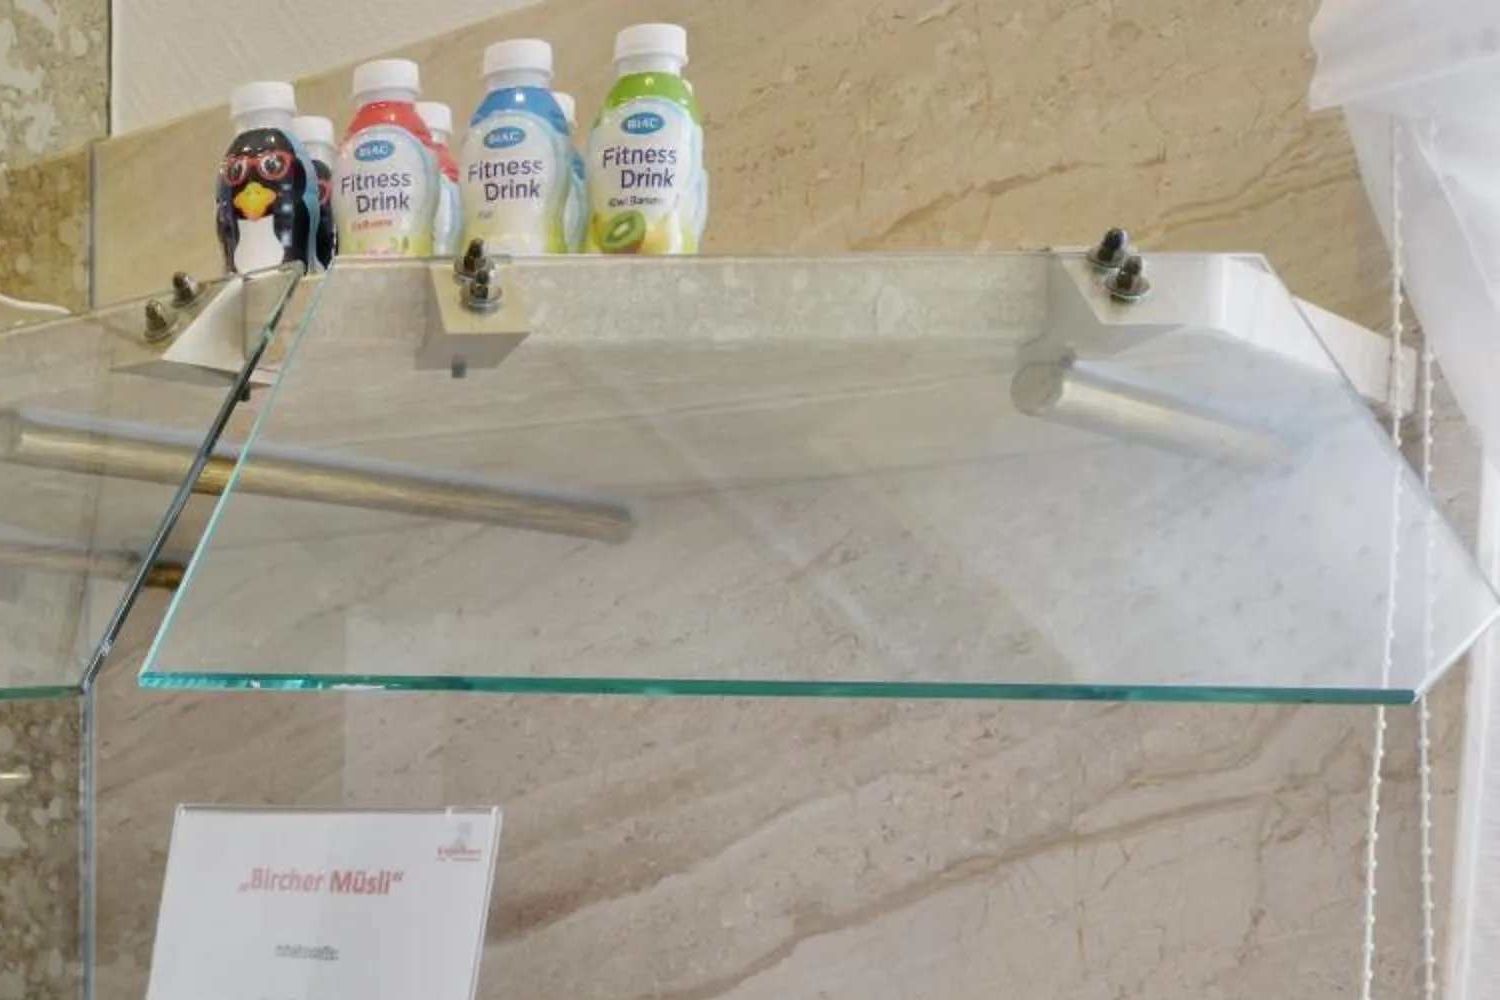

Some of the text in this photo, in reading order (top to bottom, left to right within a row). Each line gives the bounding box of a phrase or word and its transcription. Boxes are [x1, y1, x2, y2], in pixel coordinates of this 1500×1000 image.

[602, 145, 678, 170] Fitness
[467, 158, 543, 184] Fitness
[620, 167, 675, 190] Drink
[340, 172, 412, 196] Fitness
[484, 179, 541, 202] Drink
[356, 191, 411, 214] Drink
